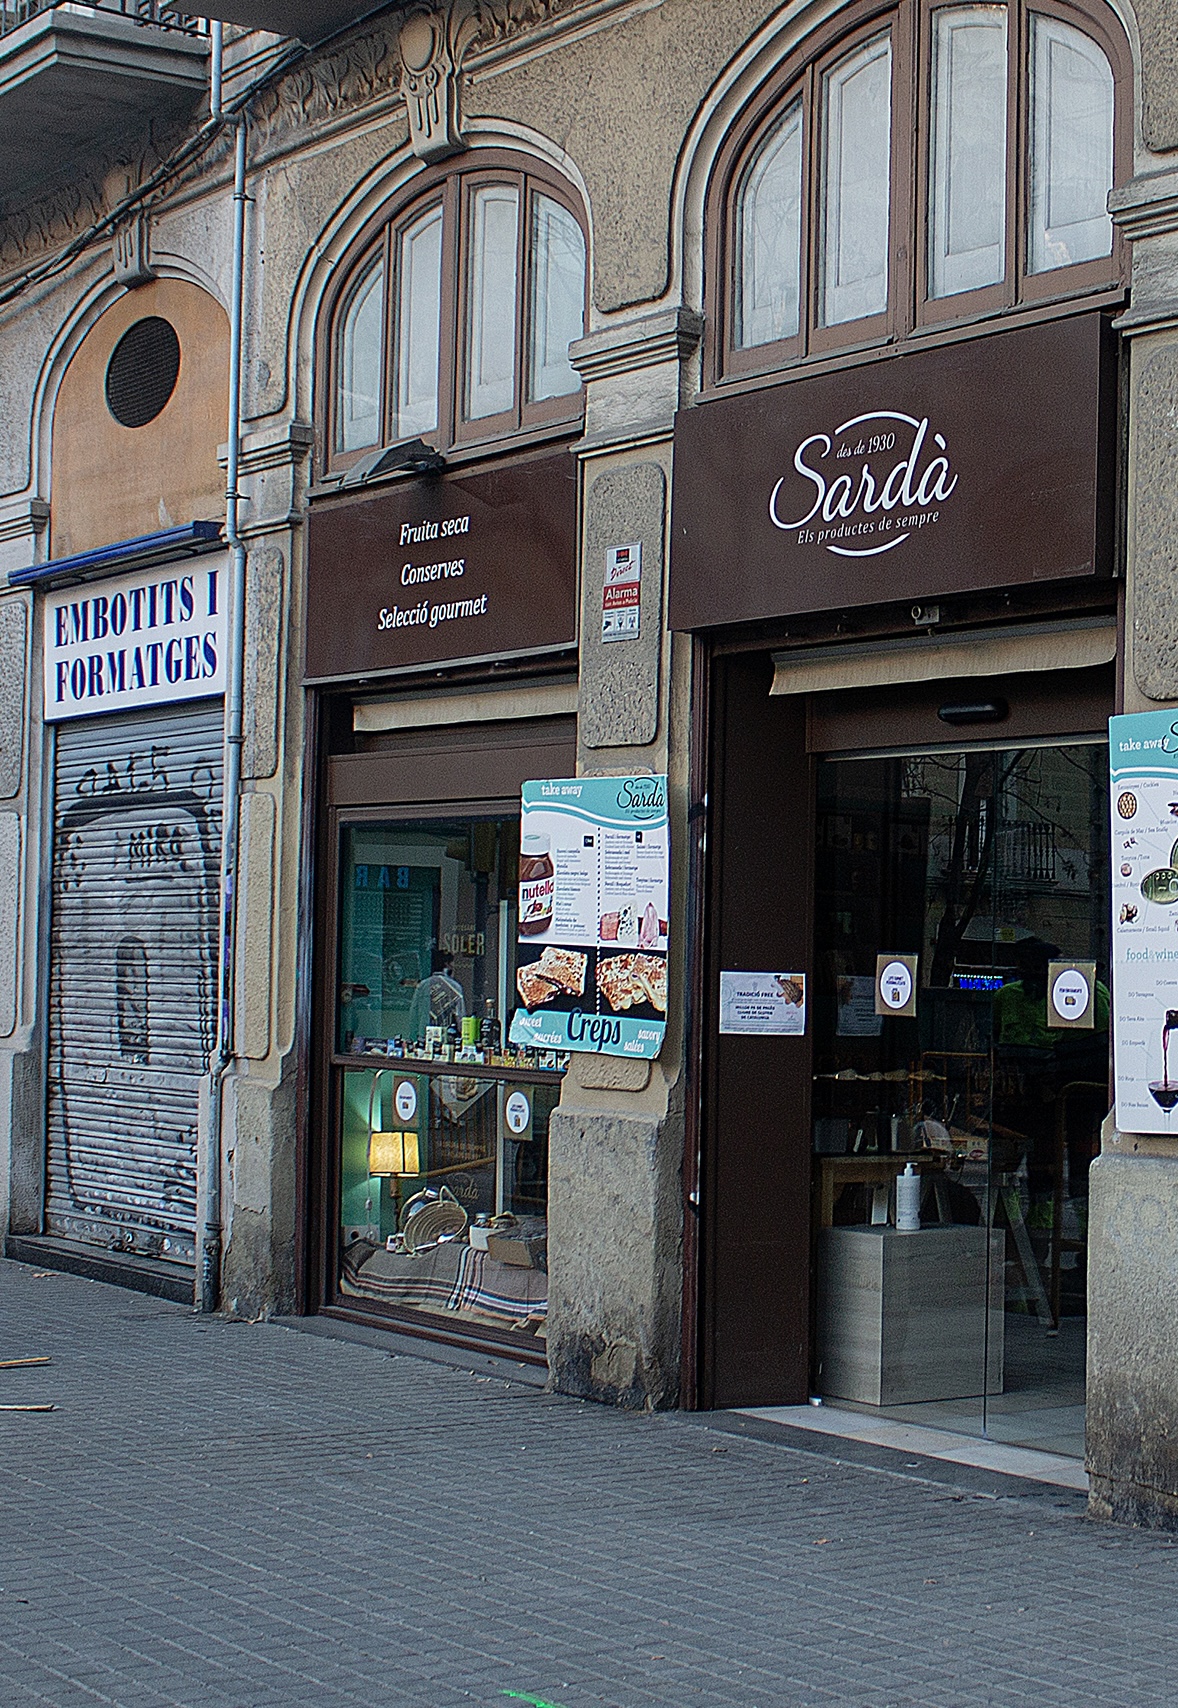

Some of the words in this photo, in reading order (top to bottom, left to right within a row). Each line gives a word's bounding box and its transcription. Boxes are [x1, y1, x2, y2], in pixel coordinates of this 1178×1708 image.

[853, 439, 865, 456] de
[868, 433, 896, 453] 1930
[769, 418, 958, 529] Sardà
[400, 522, 438, 546] Fruita
[440, 516, 470, 536] seca
[797, 530, 814, 544] Els
[817, 518, 874, 544] productes
[878, 516, 892, 530] de
[896, 510, 939, 528] sempre
[401, 559, 464, 585] Conserves
[606, 587, 637, 600] Alarma
[54, 575, 194, 648] EMBOTITS
[207, 571, 219, 616] I
[378, 601, 428, 630] Selecció
[430, 594, 488, 628] gourmet
[55, 632, 217, 702] FORMATGES
[1119, 738, 1141, 752] take
[1143, 738, 1169, 750] away
[541, 784, 559, 796] take
[561, 785, 582, 797] away
[617, 780, 664, 808] Sardà
[533, 1031, 562, 1044] sucrées
[567, 1007, 620, 1051] Creps
[638, 1029, 661, 1044] savory
[624, 1040, 644, 1053] salées
